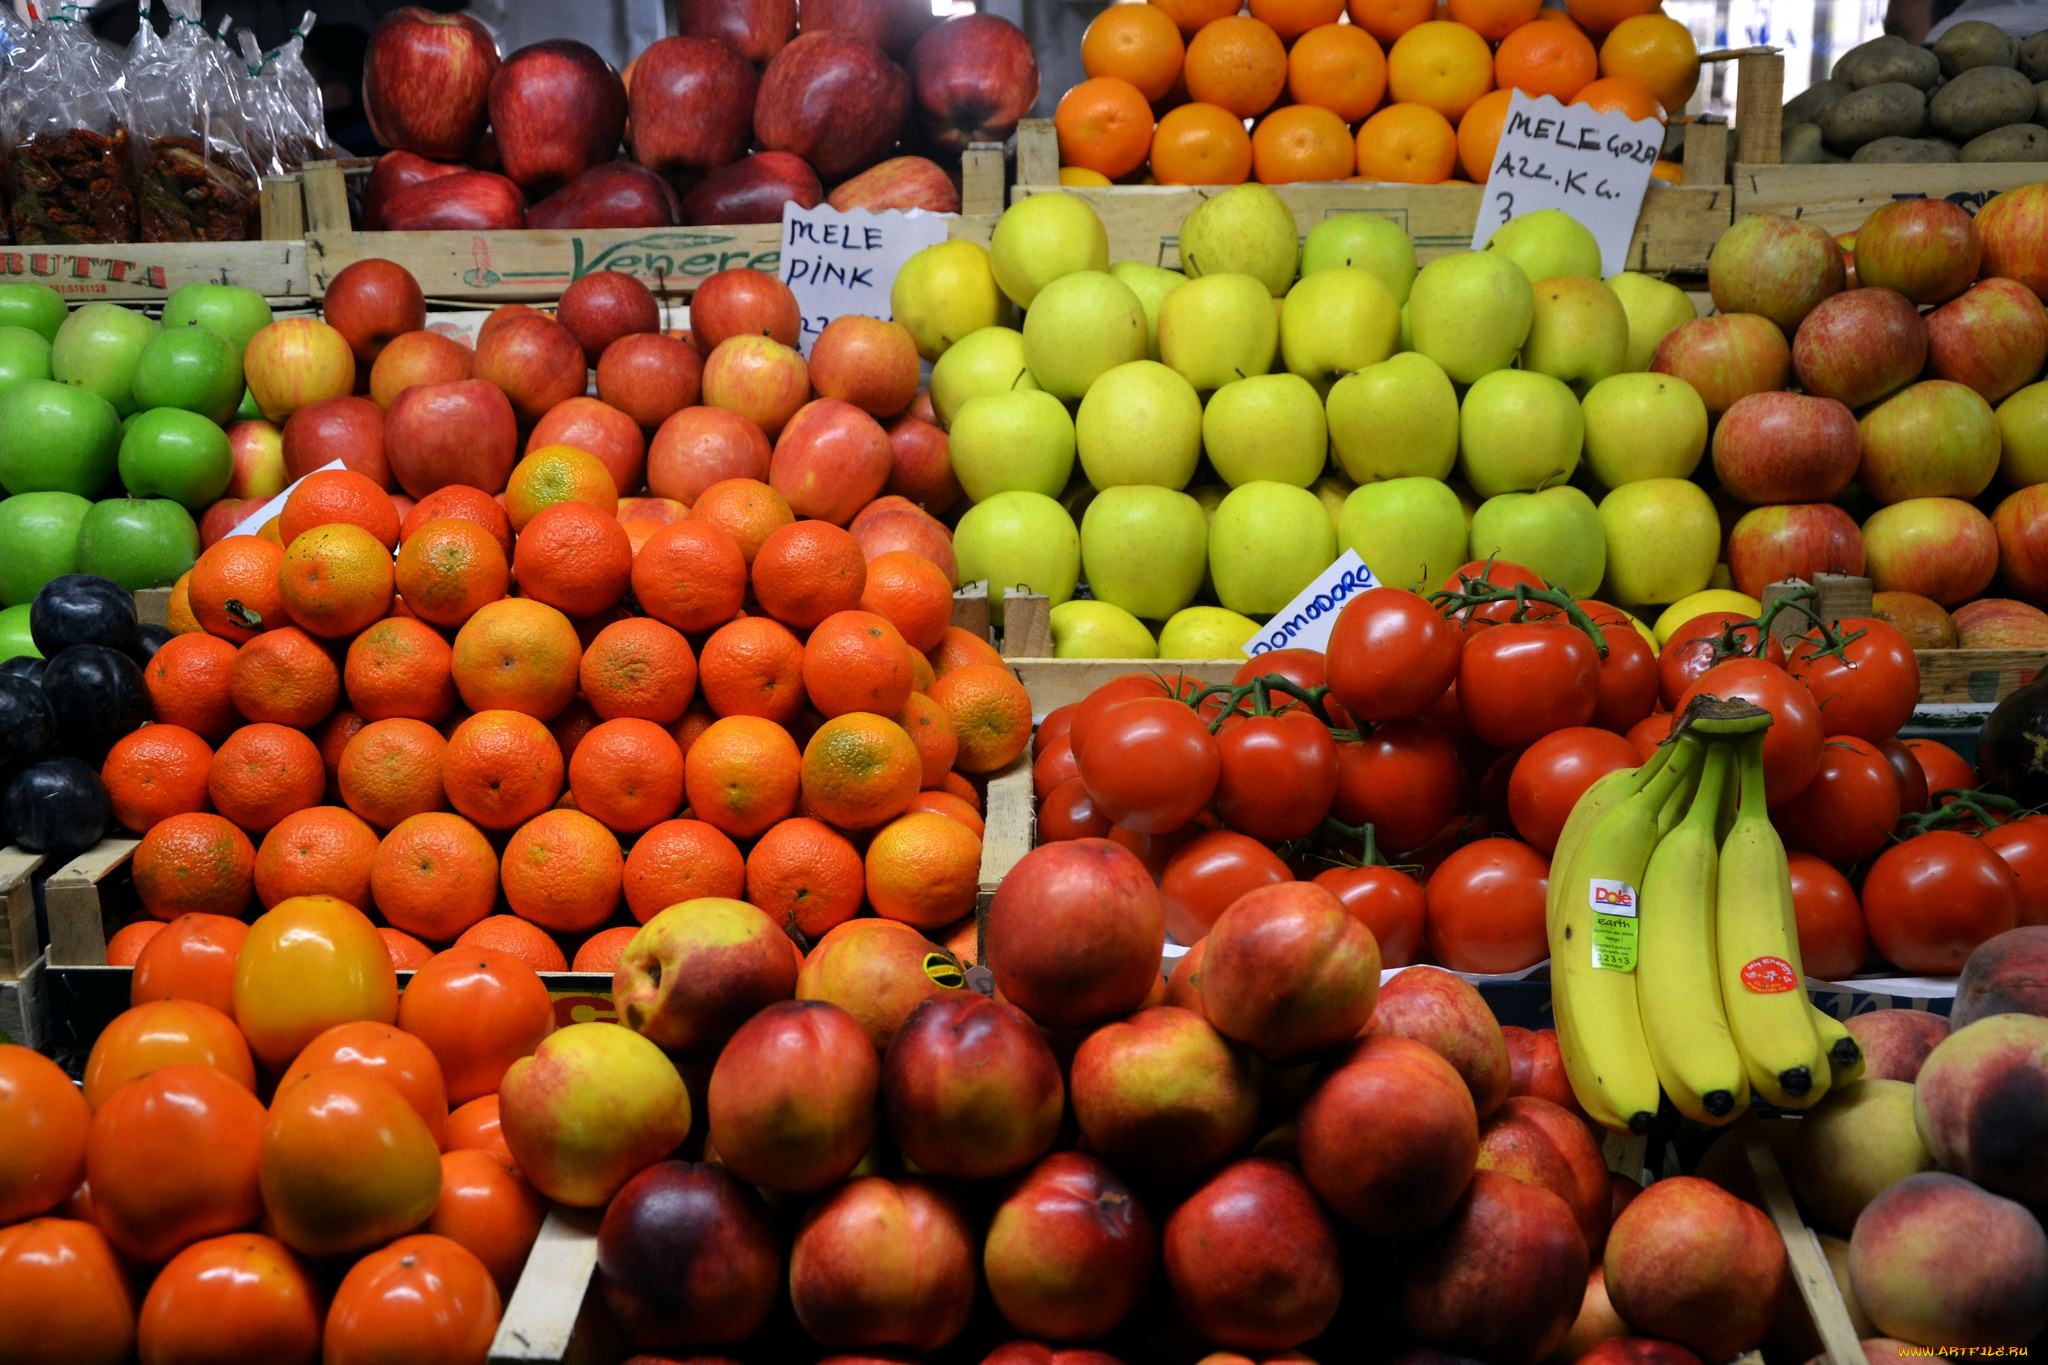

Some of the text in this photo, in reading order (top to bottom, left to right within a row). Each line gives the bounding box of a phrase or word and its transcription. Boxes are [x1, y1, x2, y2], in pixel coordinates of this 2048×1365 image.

[1507, 111, 1602, 151] MELE
[789, 219, 883, 250] MELE
[571, 235, 782, 284] Venere
[786, 255, 873, 289] PINK
[1595, 886, 1633, 906] Dole
